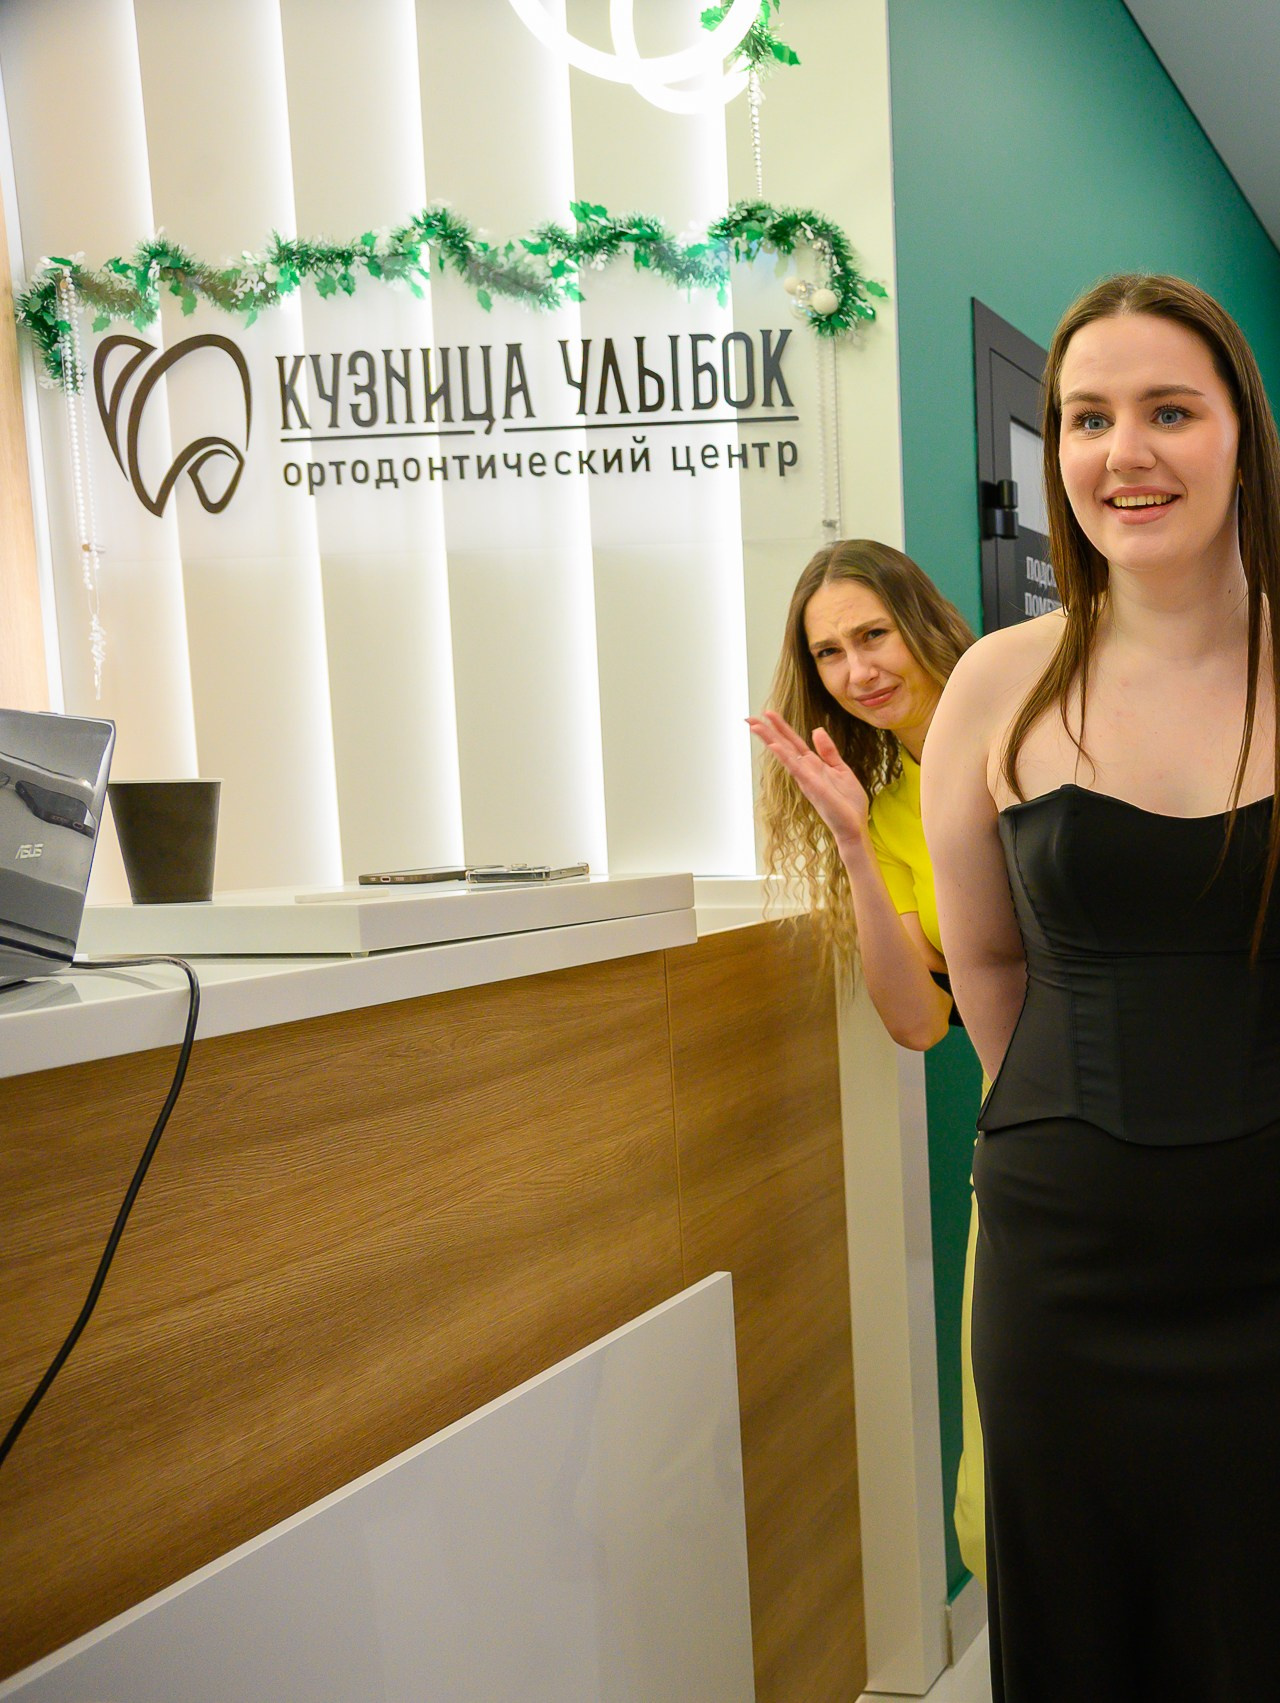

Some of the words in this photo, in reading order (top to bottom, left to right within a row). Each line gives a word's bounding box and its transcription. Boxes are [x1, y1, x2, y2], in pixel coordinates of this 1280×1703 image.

[276, 343, 536, 434] КУЗНИЦА
[558, 328, 796, 416] УЛЫБОК
[283, 436, 653, 495] ортодонтический
[671, 436, 800, 478] центр
[15, 843, 45, 859] ASUS
